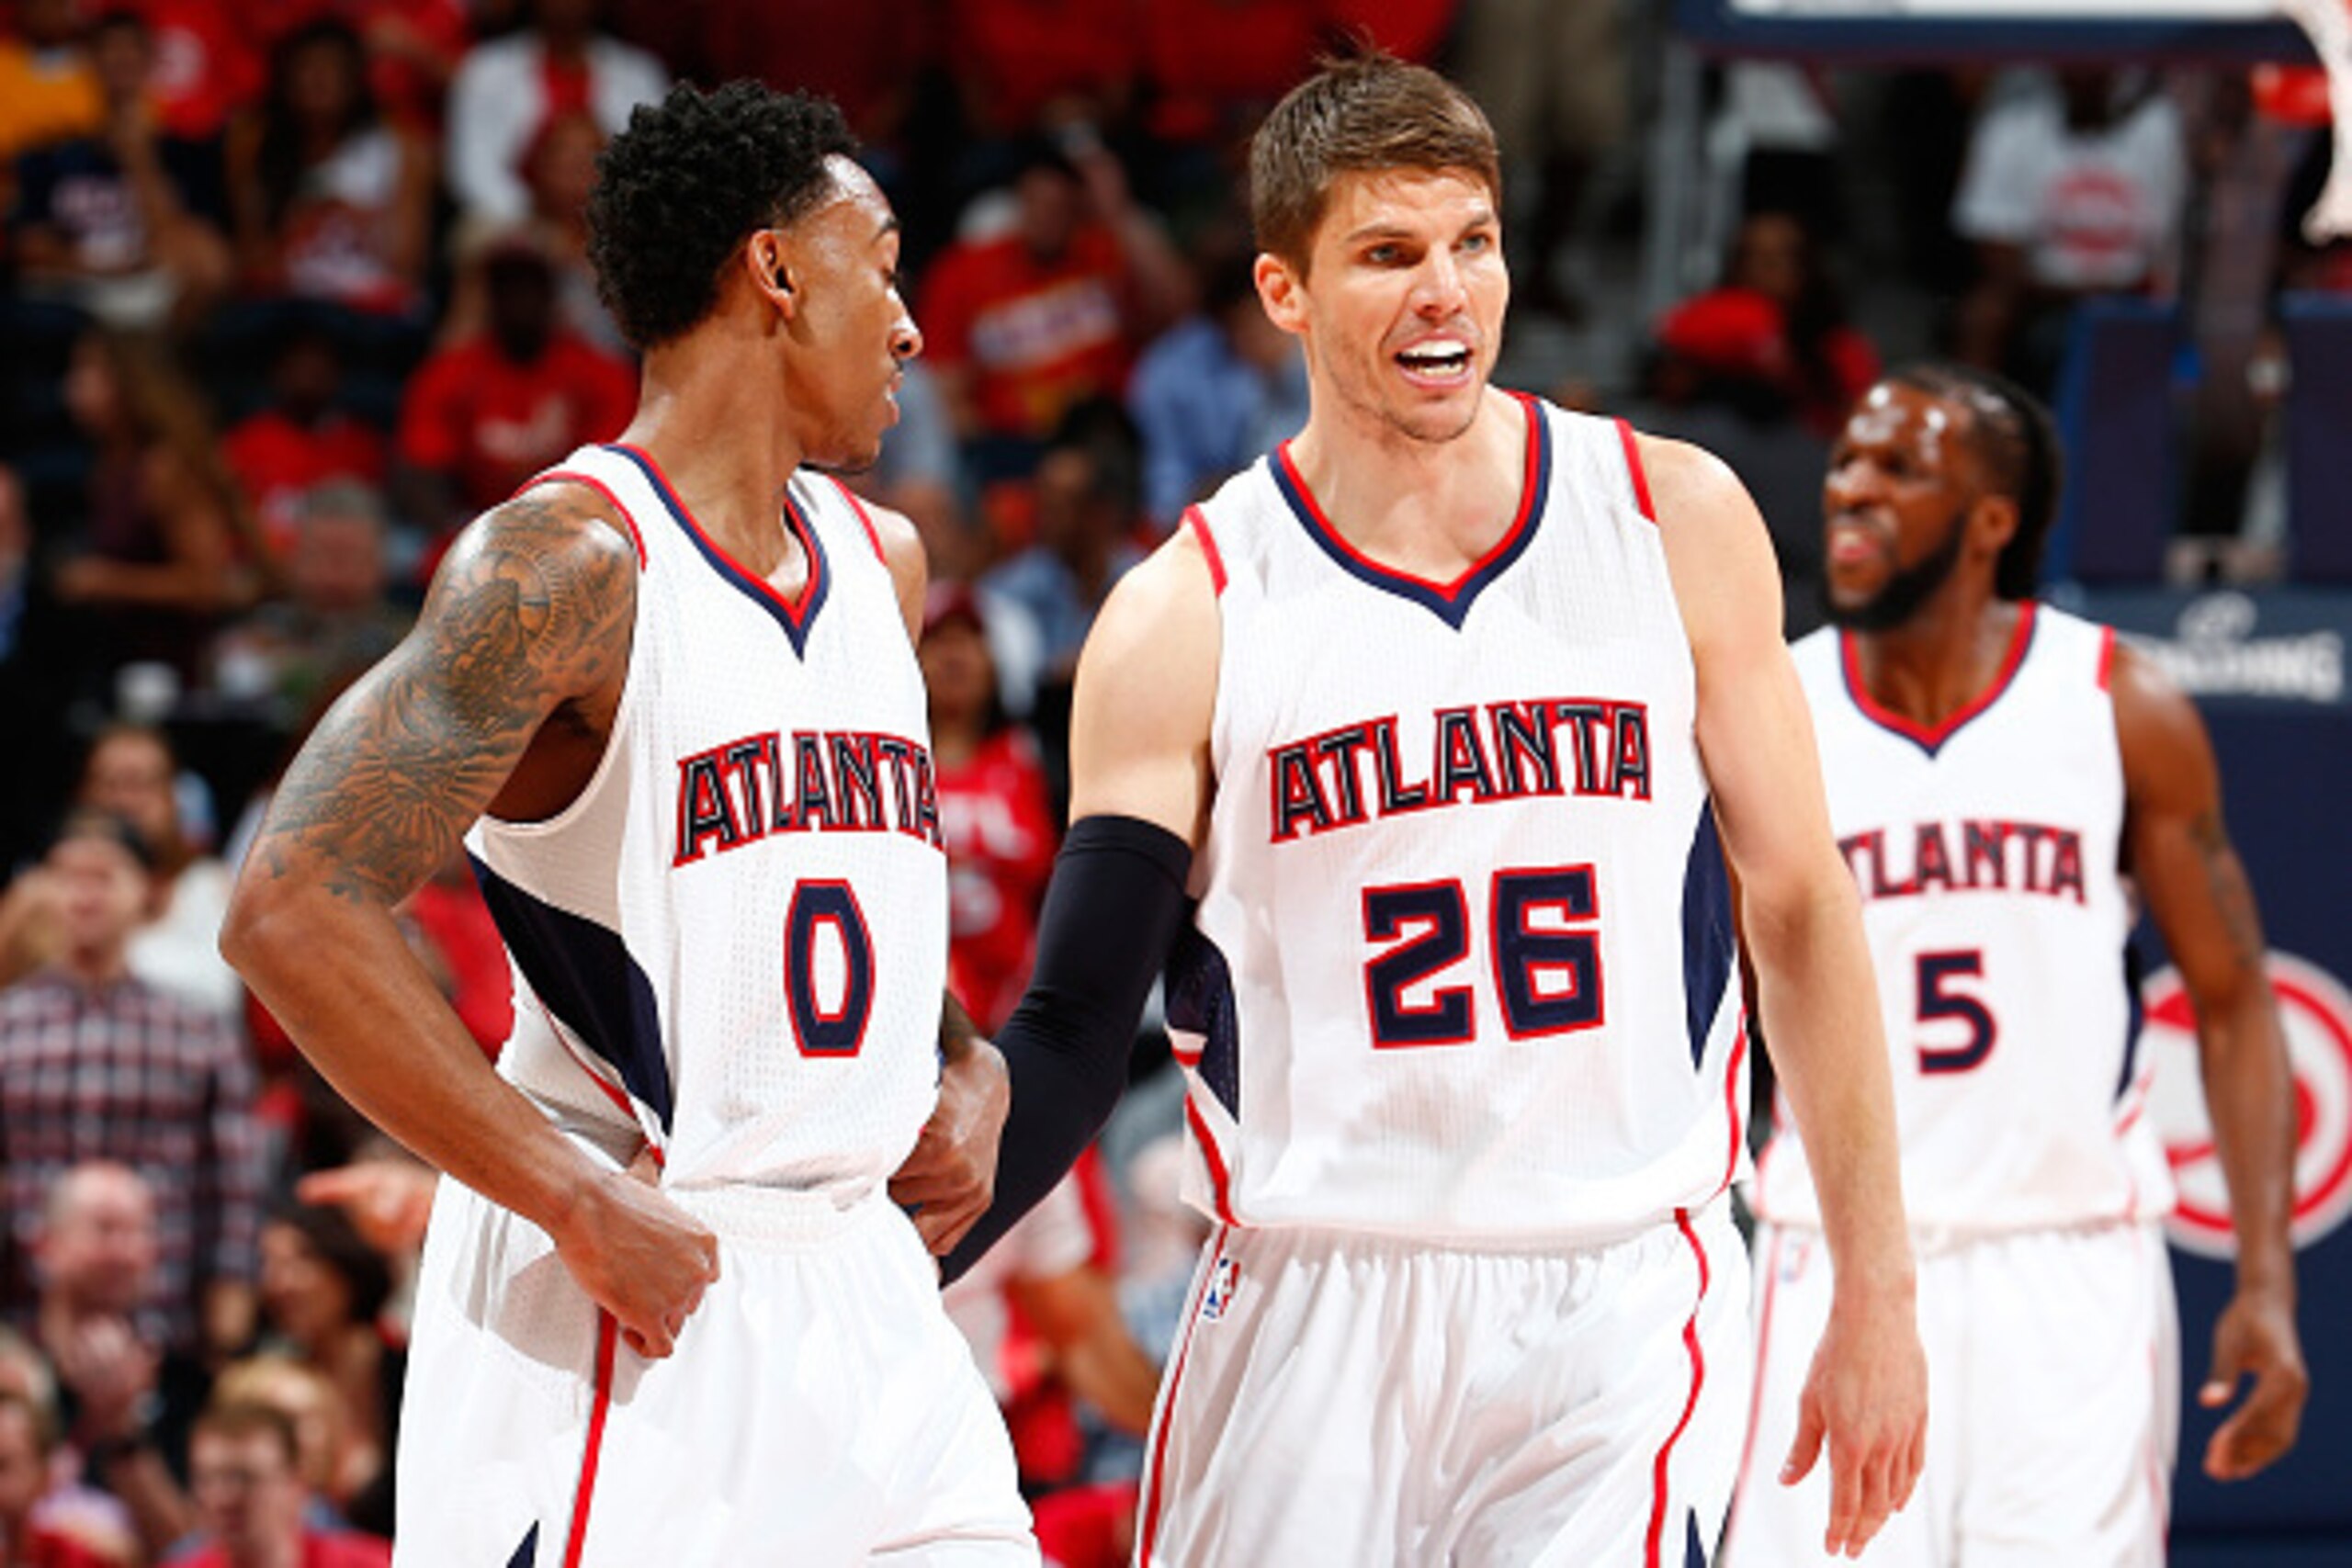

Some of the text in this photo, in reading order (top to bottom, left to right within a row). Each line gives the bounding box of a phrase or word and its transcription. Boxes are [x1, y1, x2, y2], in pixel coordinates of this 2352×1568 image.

[673, 730, 944, 868] ATLANTA
[1267, 696, 1653, 844] ATLANTA
[1837, 819, 2087, 906] TLANTA
[784, 878, 876, 1058] 0
[1361, 863, 1605, 1050] 26
[1915, 949, 1997, 1075] 5
